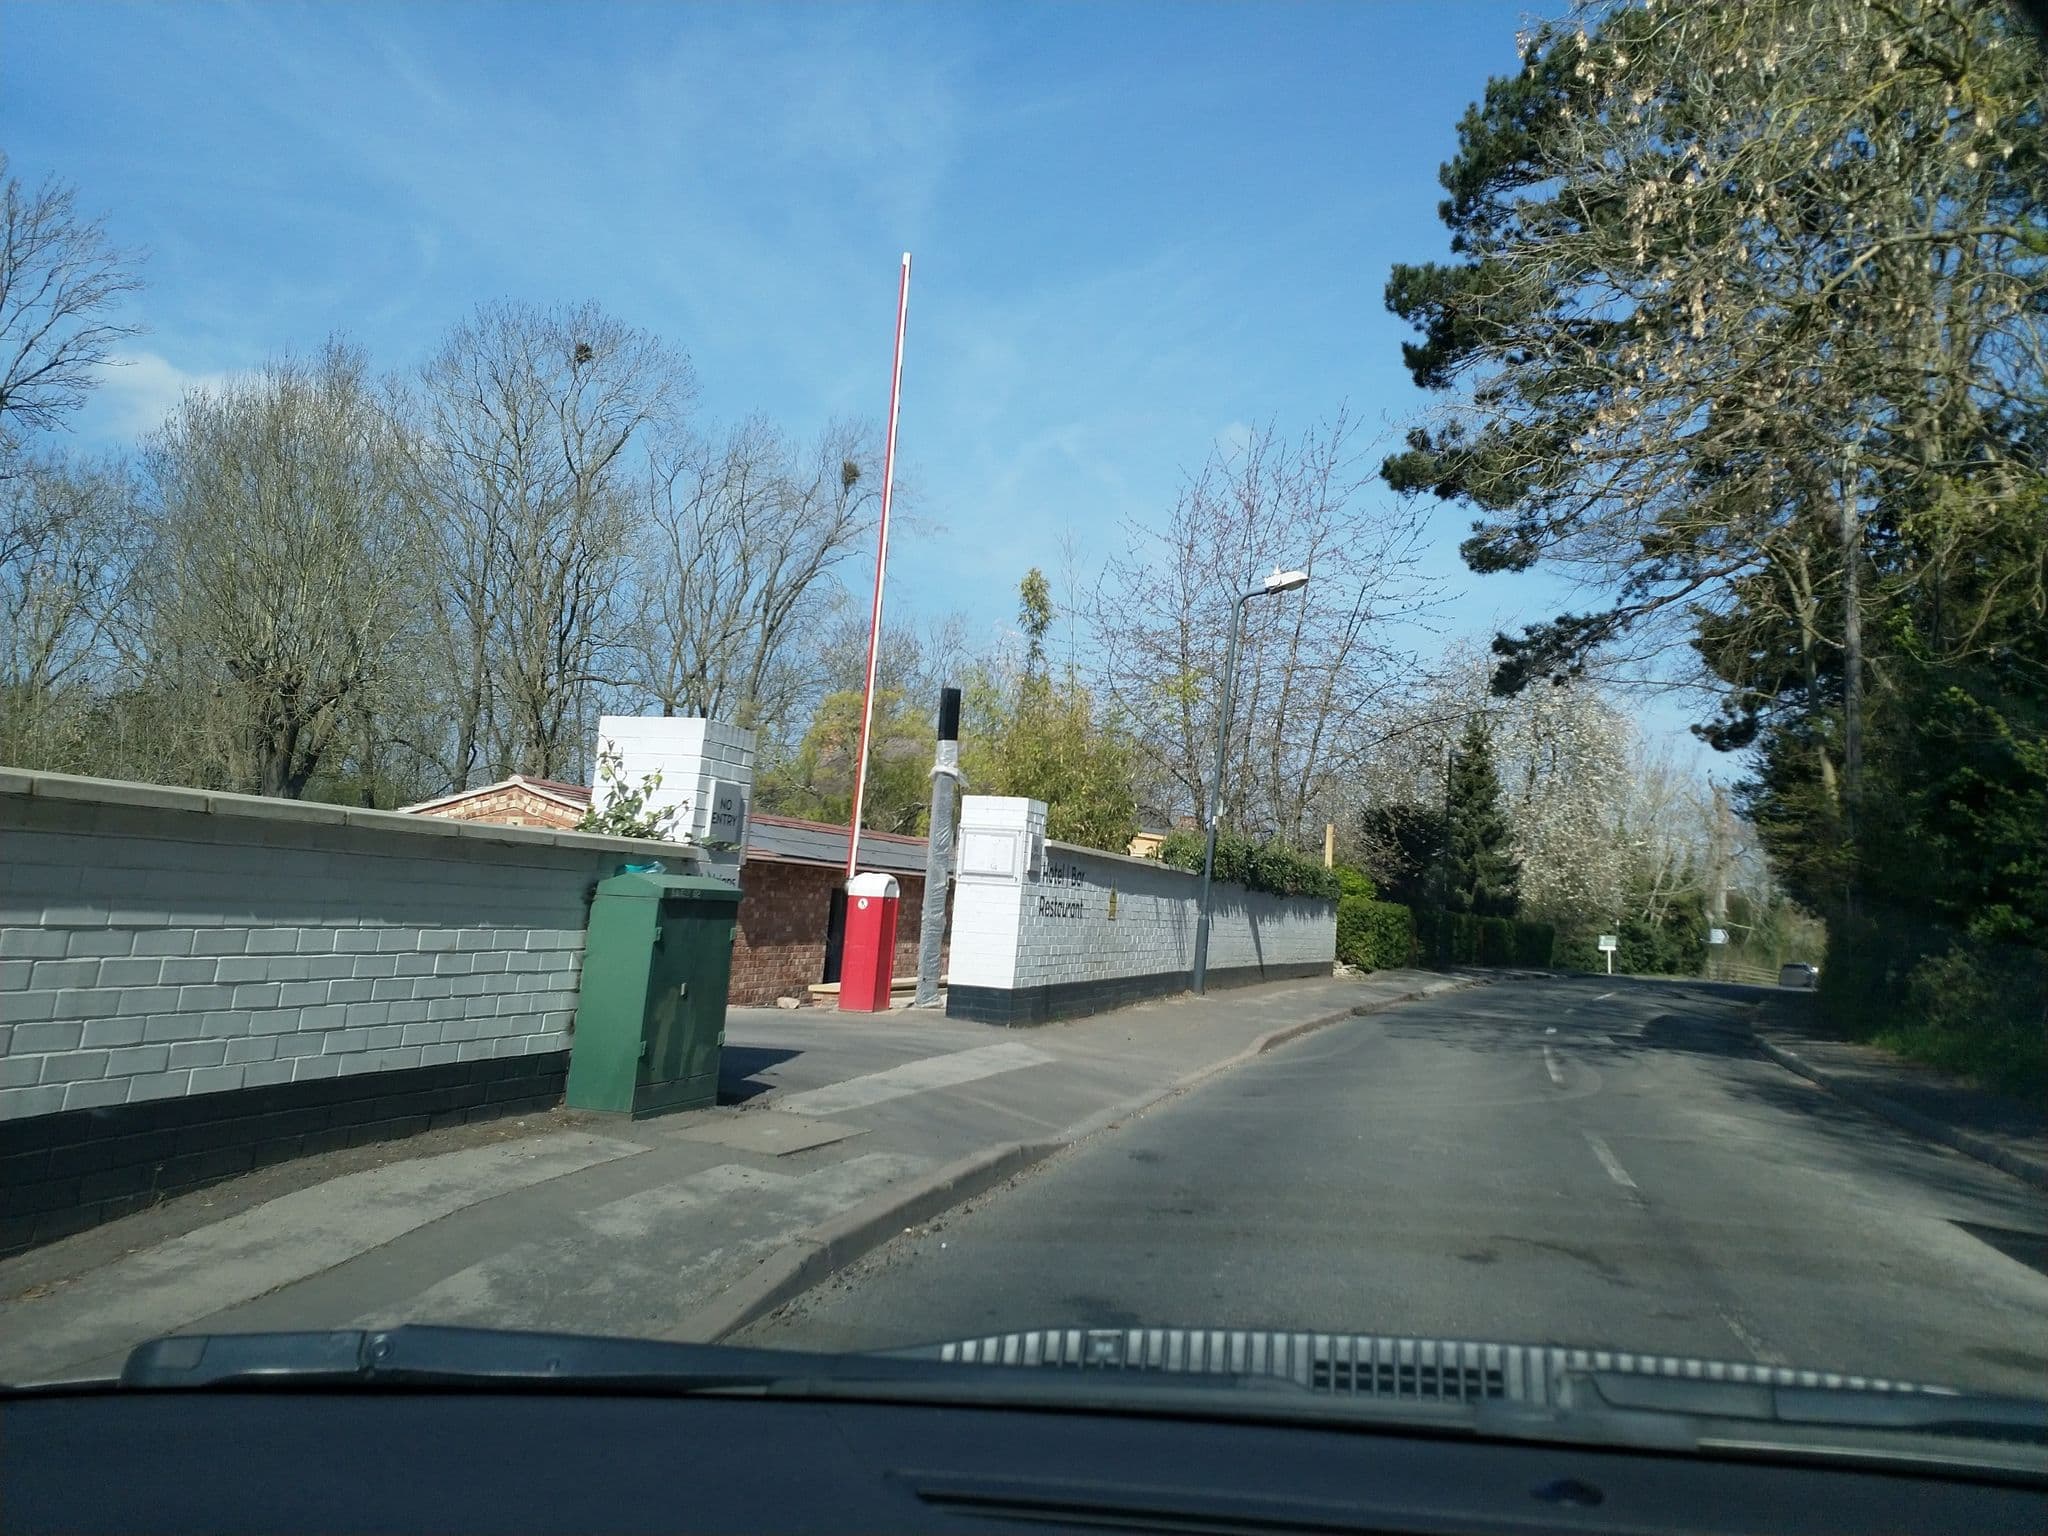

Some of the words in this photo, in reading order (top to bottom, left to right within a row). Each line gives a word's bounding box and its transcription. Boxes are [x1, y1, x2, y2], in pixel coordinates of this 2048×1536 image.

[720, 798, 733, 811] NO
[712, 812, 738, 827] ENTRY
[1042, 861, 1065, 885] Hotel
[1071, 866, 1085, 887] Bar
[1039, 895, 1083, 919] Restaurant
